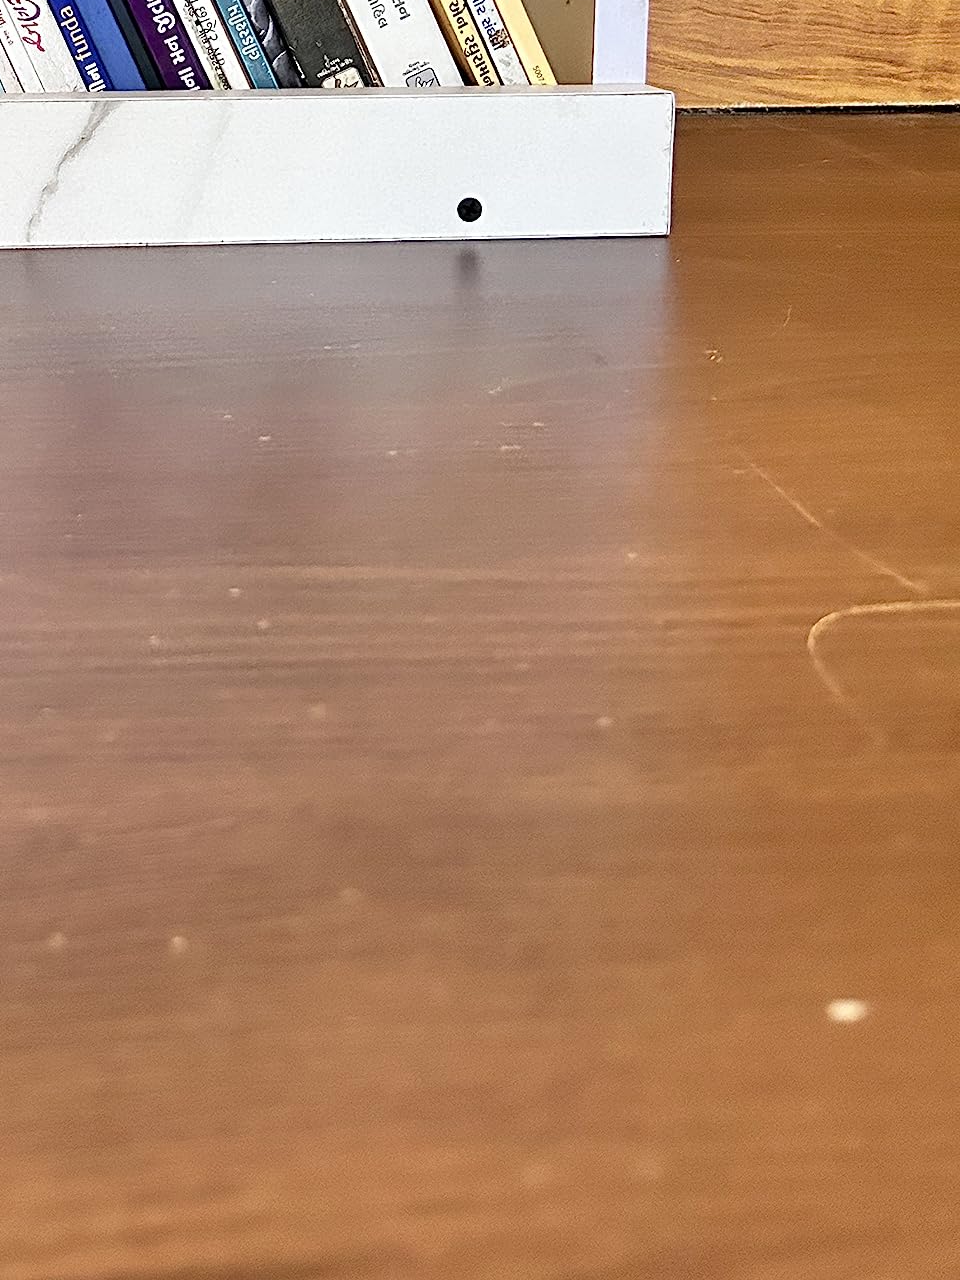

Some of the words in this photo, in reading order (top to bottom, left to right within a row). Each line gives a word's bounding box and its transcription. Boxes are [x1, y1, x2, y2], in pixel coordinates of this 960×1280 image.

[58, 4, 92, 61] funda
[162, 34, 182, 65] મન
[448, 0, 467, 34] એન.
[463, 34, 494, 86] રઘુરામન
[177, 65, 200, 91] ના
